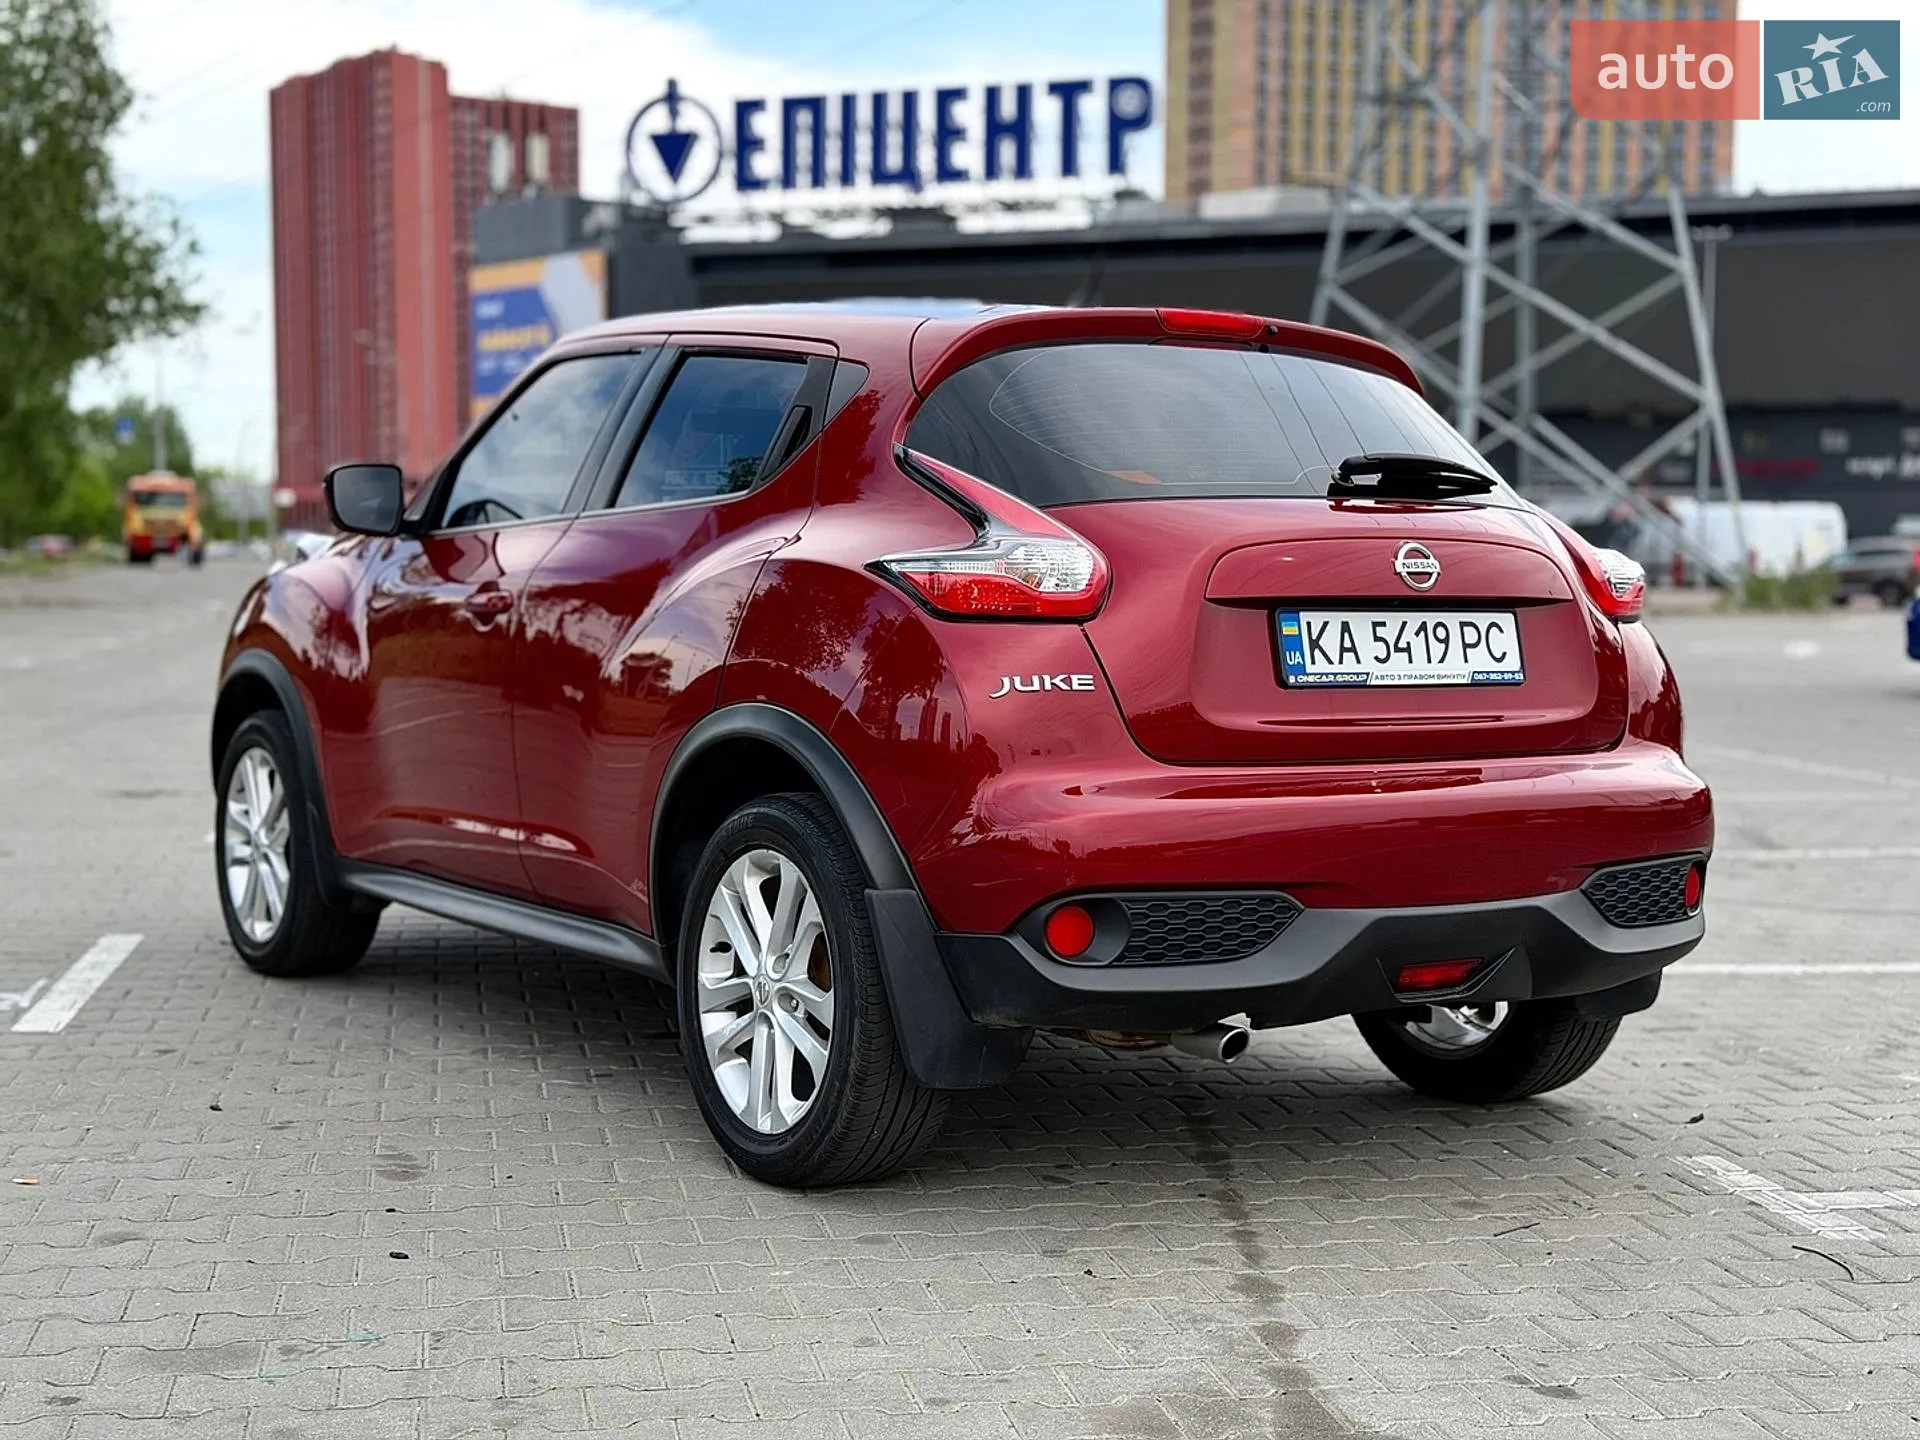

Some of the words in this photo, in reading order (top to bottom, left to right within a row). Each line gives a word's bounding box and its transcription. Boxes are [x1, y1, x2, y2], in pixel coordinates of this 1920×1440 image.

[734, 76, 1153, 193] ЕПІЦЕНТР
[1401, 561, 1437, 570] NISSAN
[1306, 620, 1362, 666] KA
[1371, 620, 1450, 665] 5419
[1458, 620, 1508, 664] PC
[1286, 650, 1304, 666] UA
[988, 674, 1096, 699] JUKE
[1336, 673, 1368, 682] GROUP
